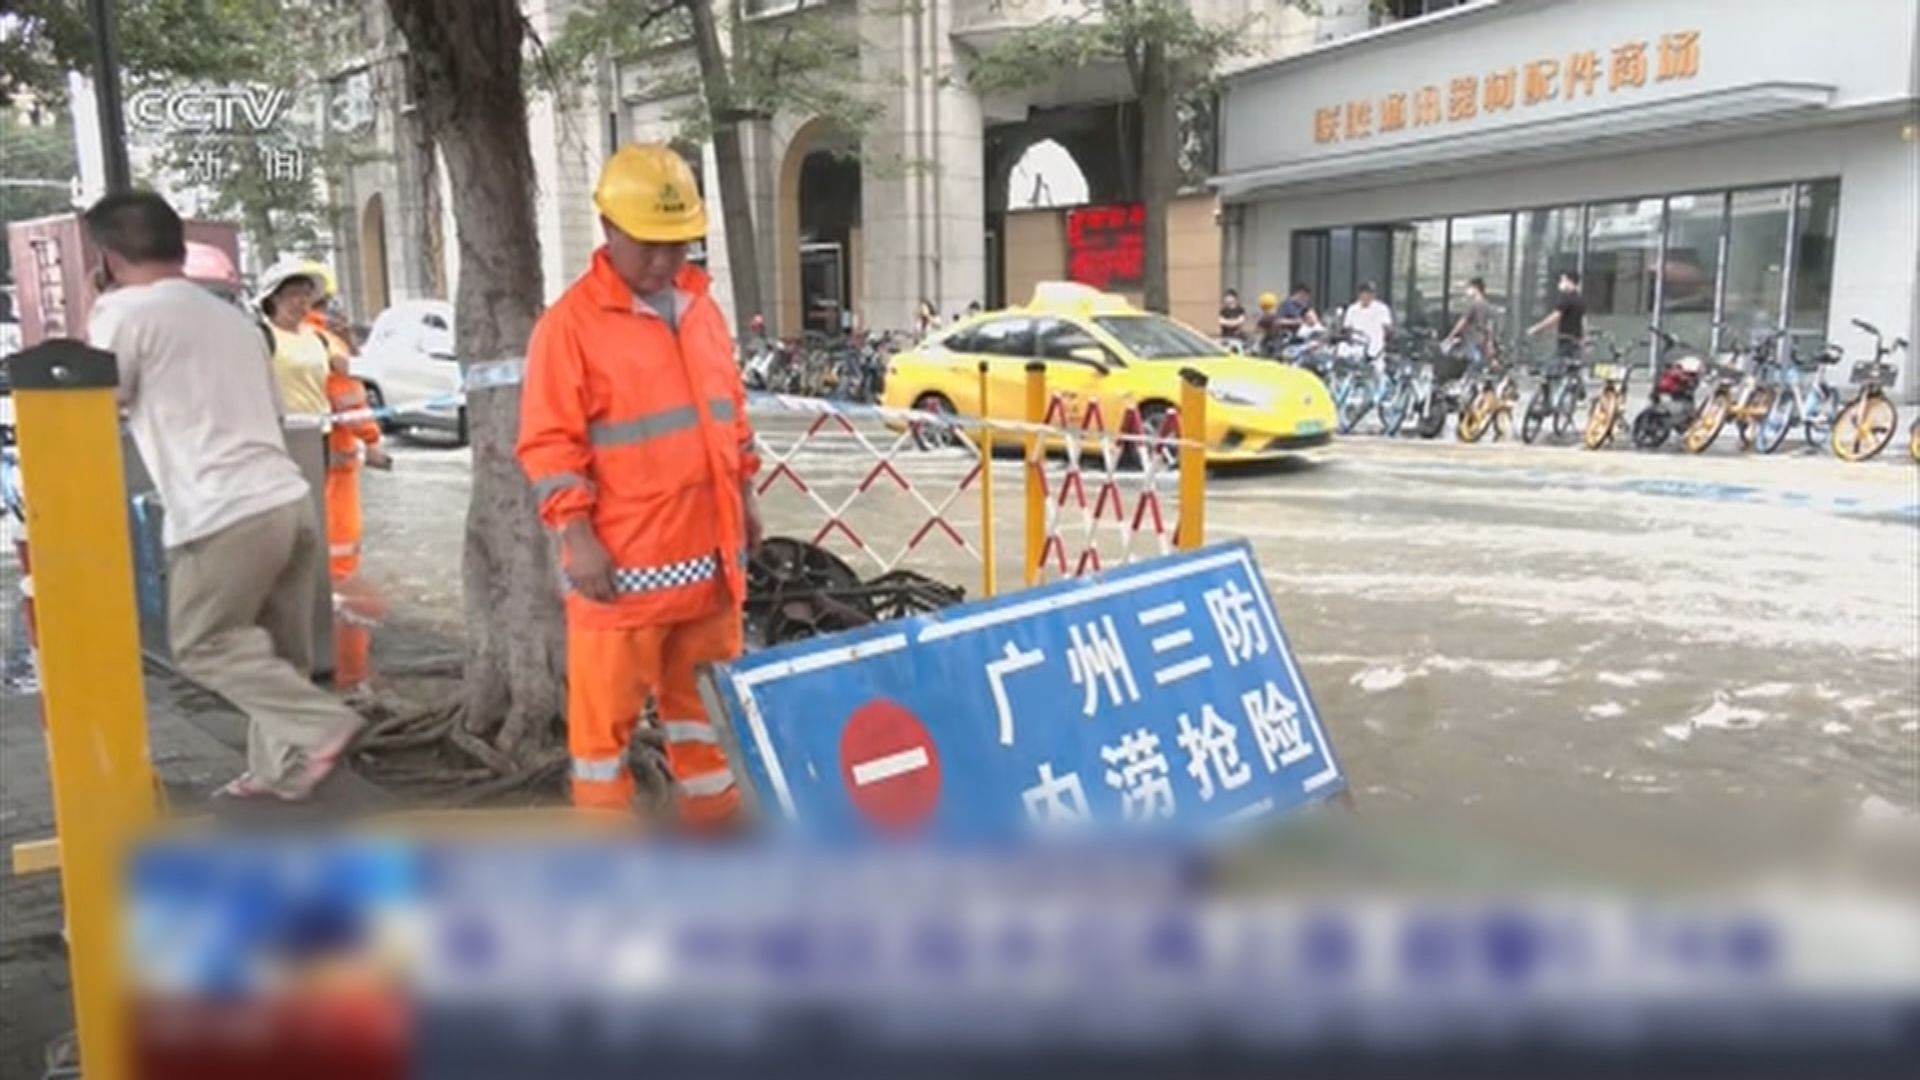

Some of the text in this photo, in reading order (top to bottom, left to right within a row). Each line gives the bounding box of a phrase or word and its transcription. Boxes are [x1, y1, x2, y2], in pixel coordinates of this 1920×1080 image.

[985, 579, 1269, 744] 广州三防
[1021, 681, 1313, 825] 内涝抢险
